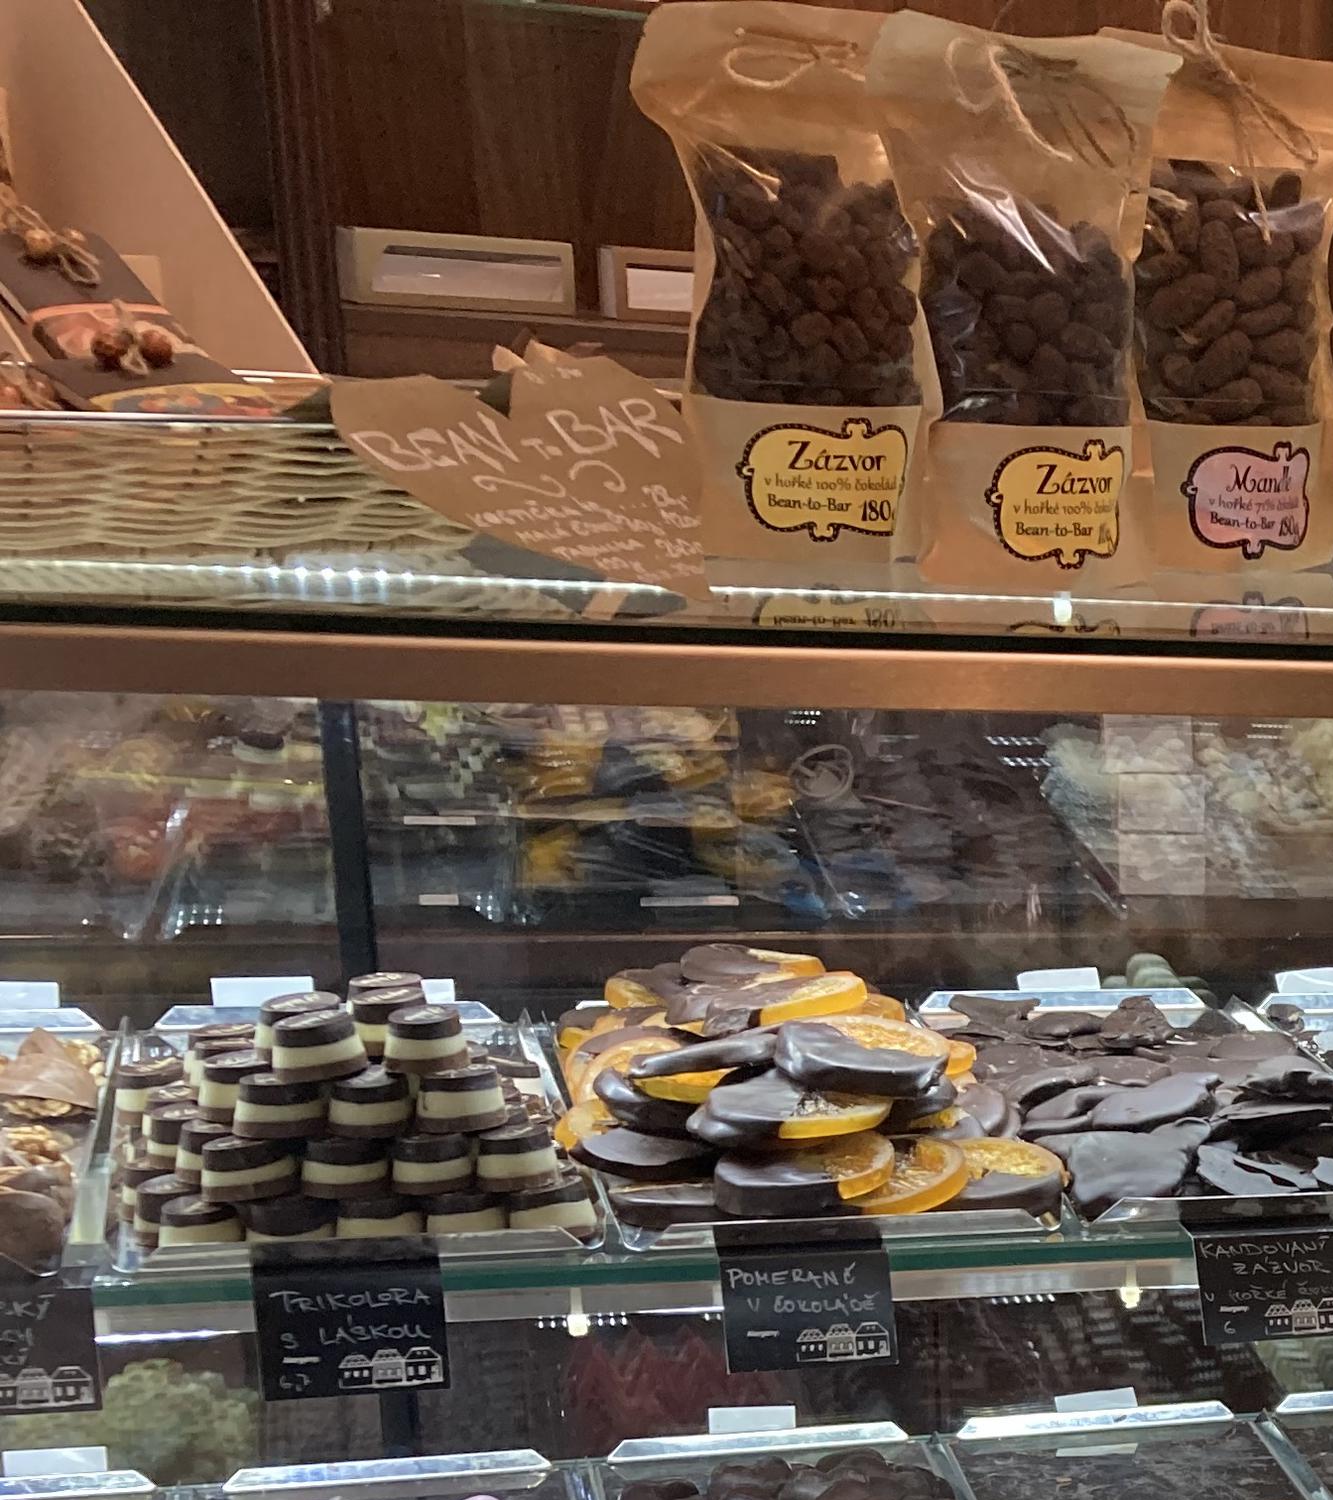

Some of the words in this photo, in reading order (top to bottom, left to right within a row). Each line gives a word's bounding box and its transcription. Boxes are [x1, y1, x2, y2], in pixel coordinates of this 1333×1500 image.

[350, 411, 521, 472] BEAN
[545, 398, 686, 459] BAR
[788, 440, 887, 472] Zázvor
[764, 477, 772, 487] v
[775, 473, 813, 491] hořké
[816, 476, 851, 491] 100%
[1036, 463, 1113, 496] Zázvor
[767, 493, 852, 513] Bean-to-Bar
[1013, 503, 1021, 515] v
[1024, 498, 1060, 516] hořké
[1015, 521, 1094, 537] Bean-to-Bar
[1209, 511, 1276, 531] Bean-to-Bar
[1200, 1234, 1331, 1260] KANDOVANÝ
[725, 1260, 857, 1290] POMERANČ
[1232, 1256, 1332, 1276] ZÁZVOR
[268, 1289, 432, 1315] TRIKOLORA
[747, 1297, 761, 1313] V
[319, 1313, 432, 1347] LÁSKOU
[1224, 1320, 1237, 1335] 6
